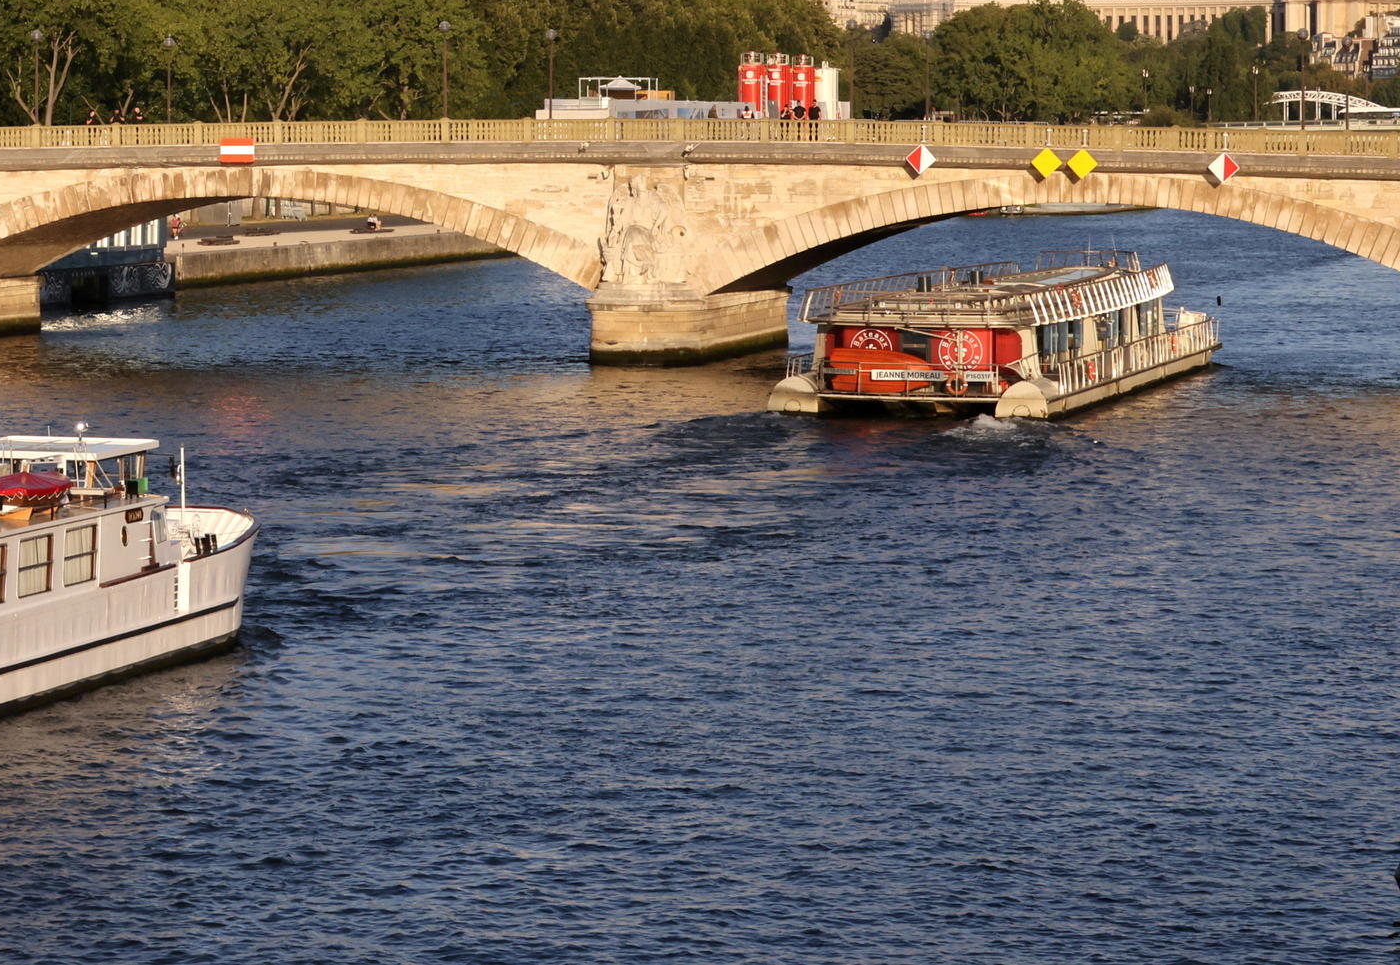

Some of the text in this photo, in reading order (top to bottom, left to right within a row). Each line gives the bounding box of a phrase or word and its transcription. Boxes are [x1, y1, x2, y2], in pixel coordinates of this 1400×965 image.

[853, 332, 889, 348] Bateaux
[876, 371, 941, 380] JEANNE MOREAU
